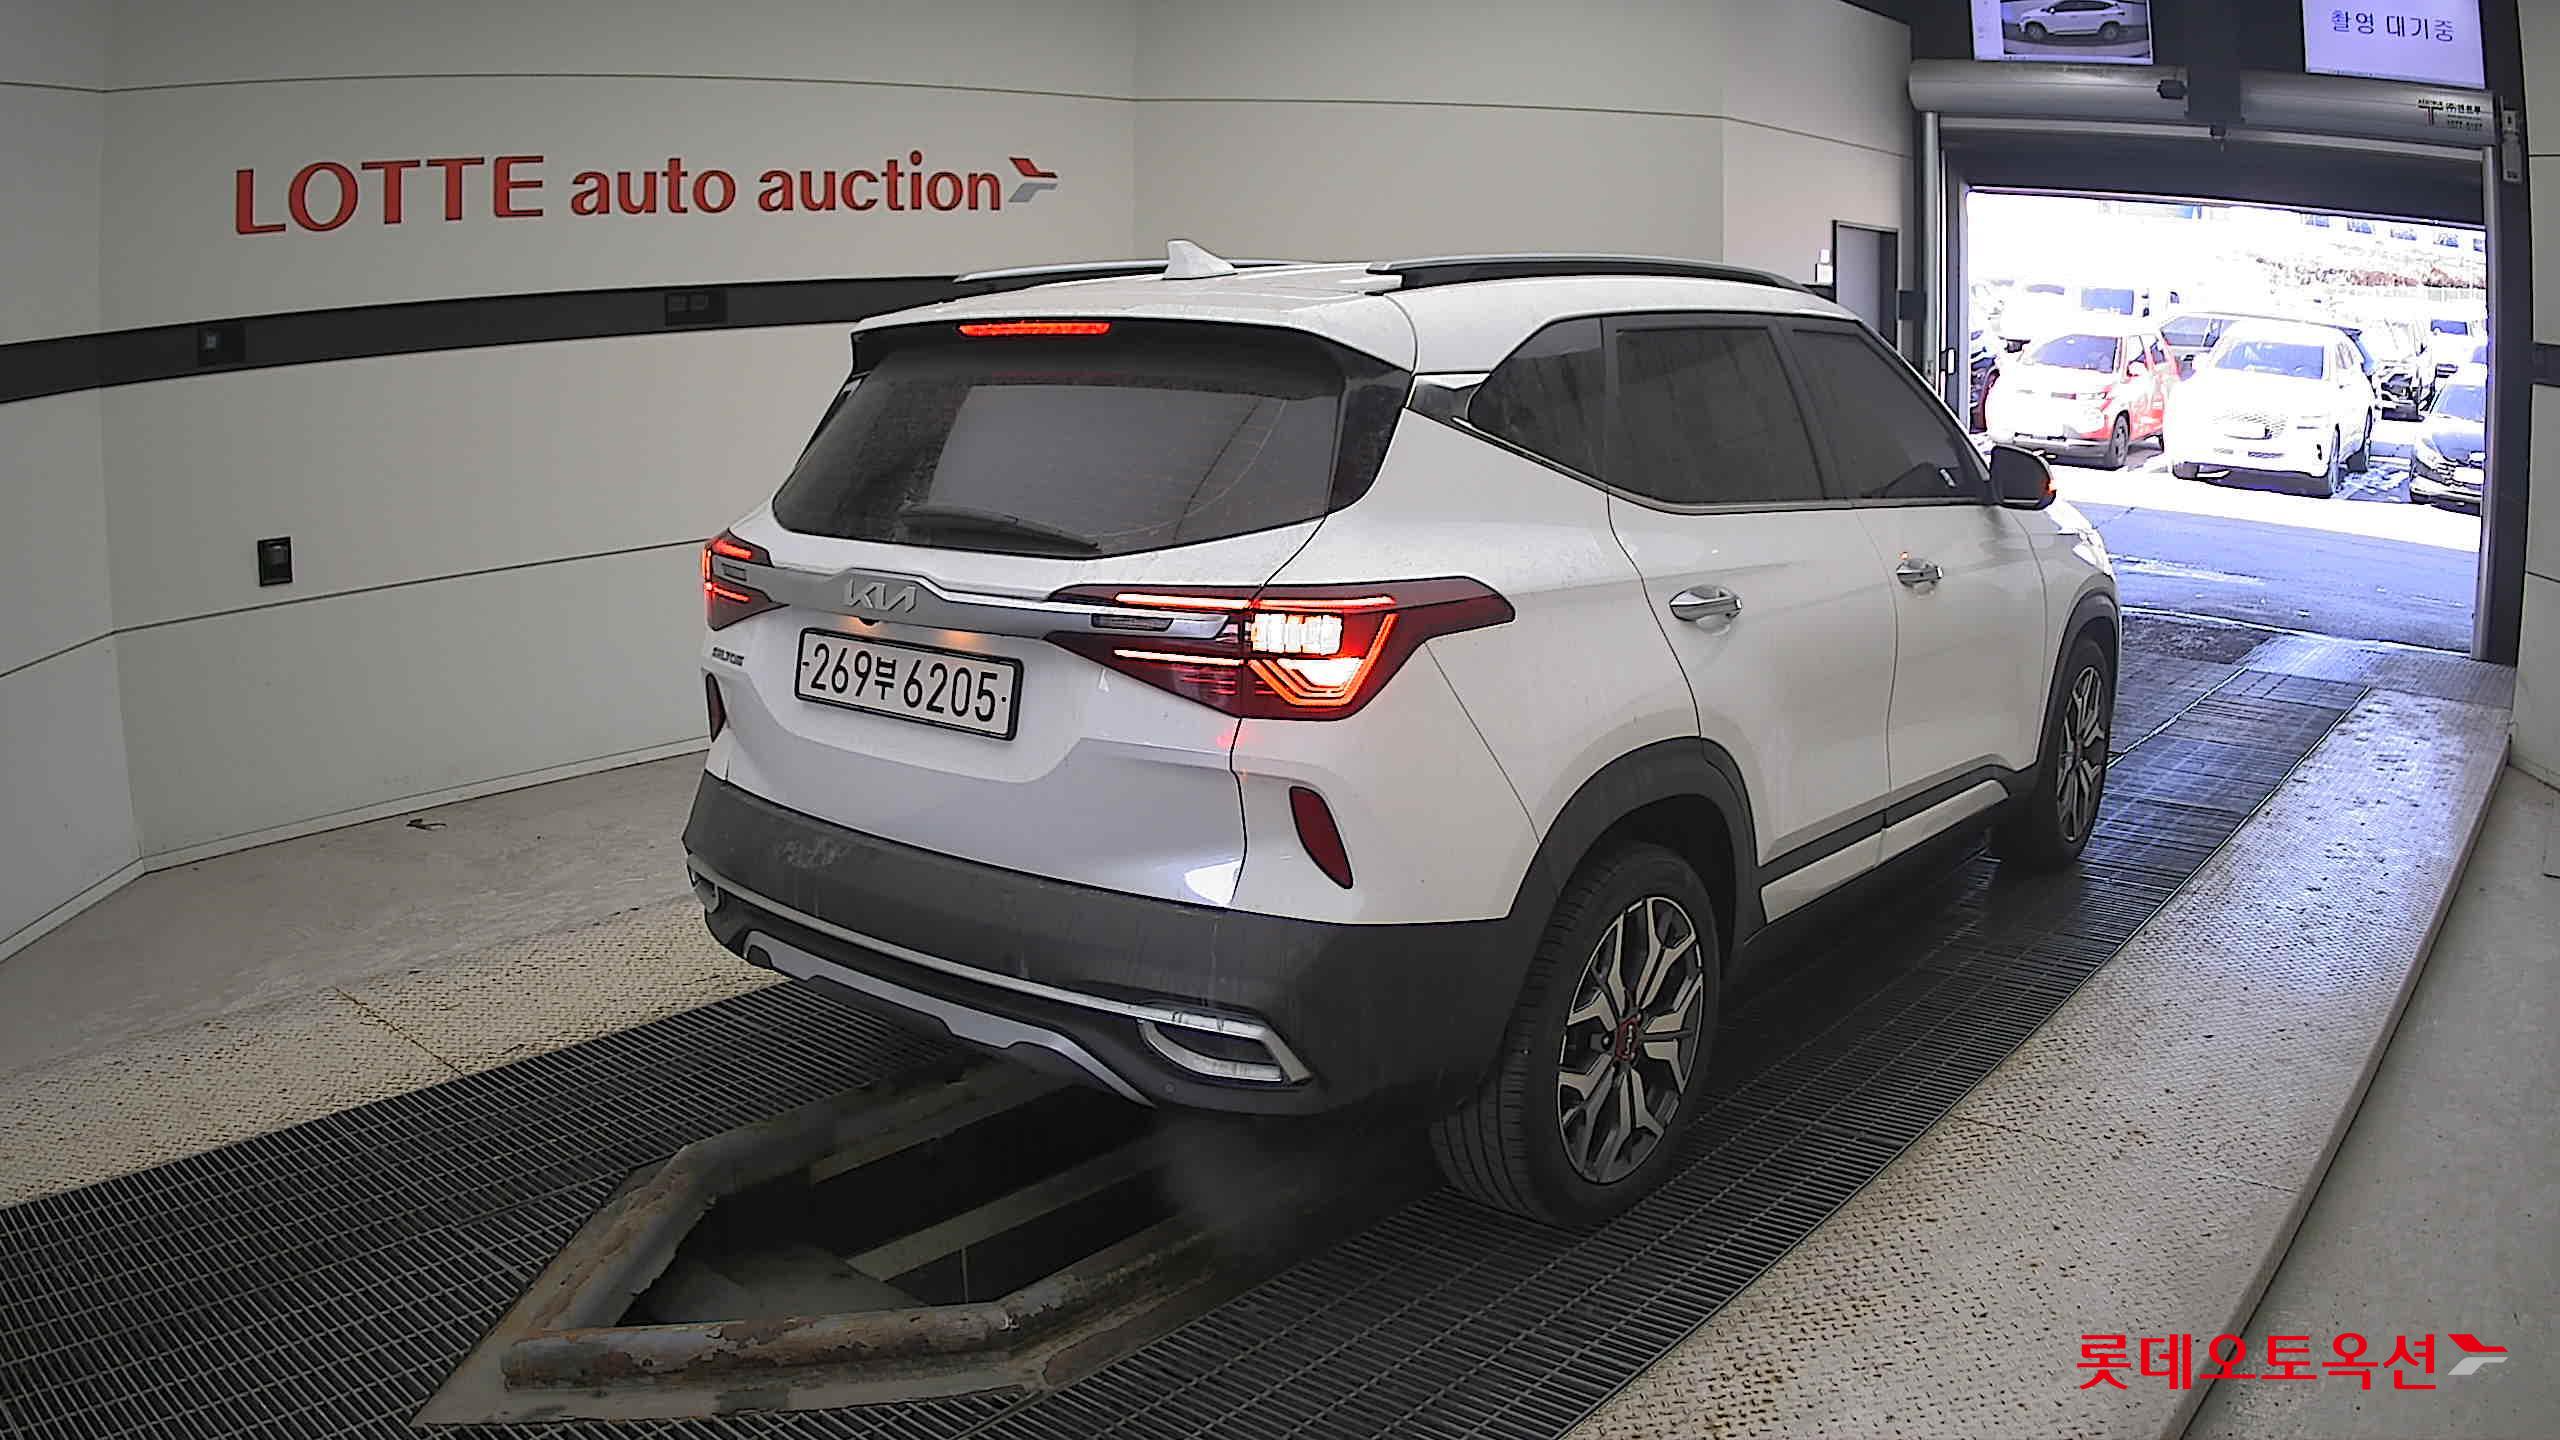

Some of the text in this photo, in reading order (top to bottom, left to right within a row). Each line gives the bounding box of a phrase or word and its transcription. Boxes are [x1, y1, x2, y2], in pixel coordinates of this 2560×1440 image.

[2331, 9, 2375, 35] 촬영
[235, 150, 1002, 234] LOTTE auto auction
